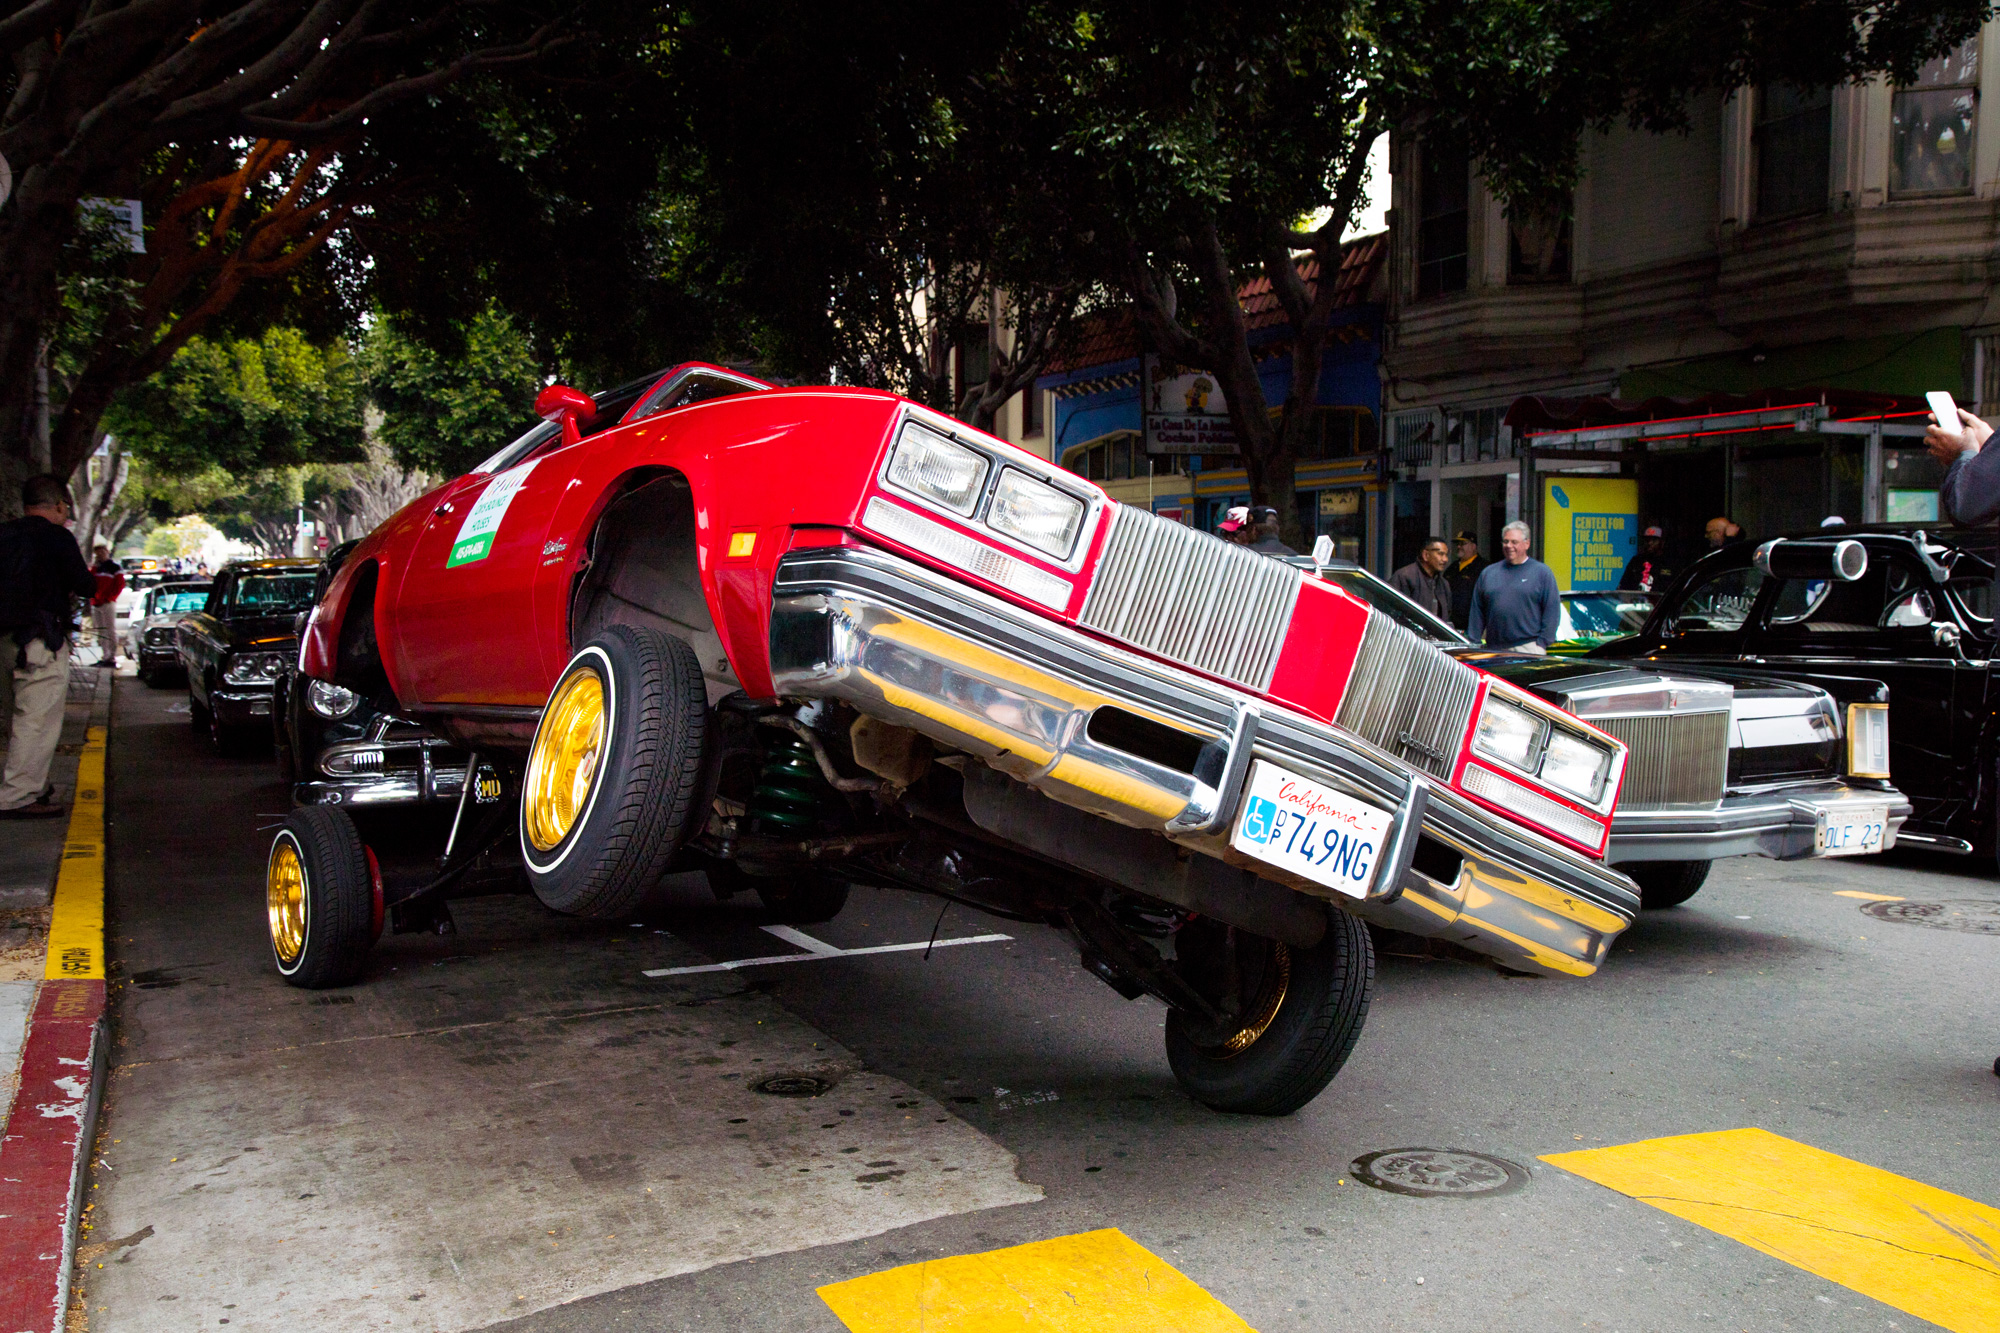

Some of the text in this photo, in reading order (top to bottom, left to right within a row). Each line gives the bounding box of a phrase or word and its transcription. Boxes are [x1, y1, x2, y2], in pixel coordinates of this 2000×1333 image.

[1162, 418, 1183, 431] Casa
[1575, 517, 1625, 530] CENTER FOR
[1575, 530, 1609, 542] THE ART
[1575, 543, 1613, 555] OF DOING
[1575, 556, 1623, 568] SOMETHING
[1575, 569, 1612, 581] ABOUT IT
[1278, 781, 1364, 831] California
[1861, 824, 1882, 846] 23
[1285, 812, 1373, 881] 749NG
